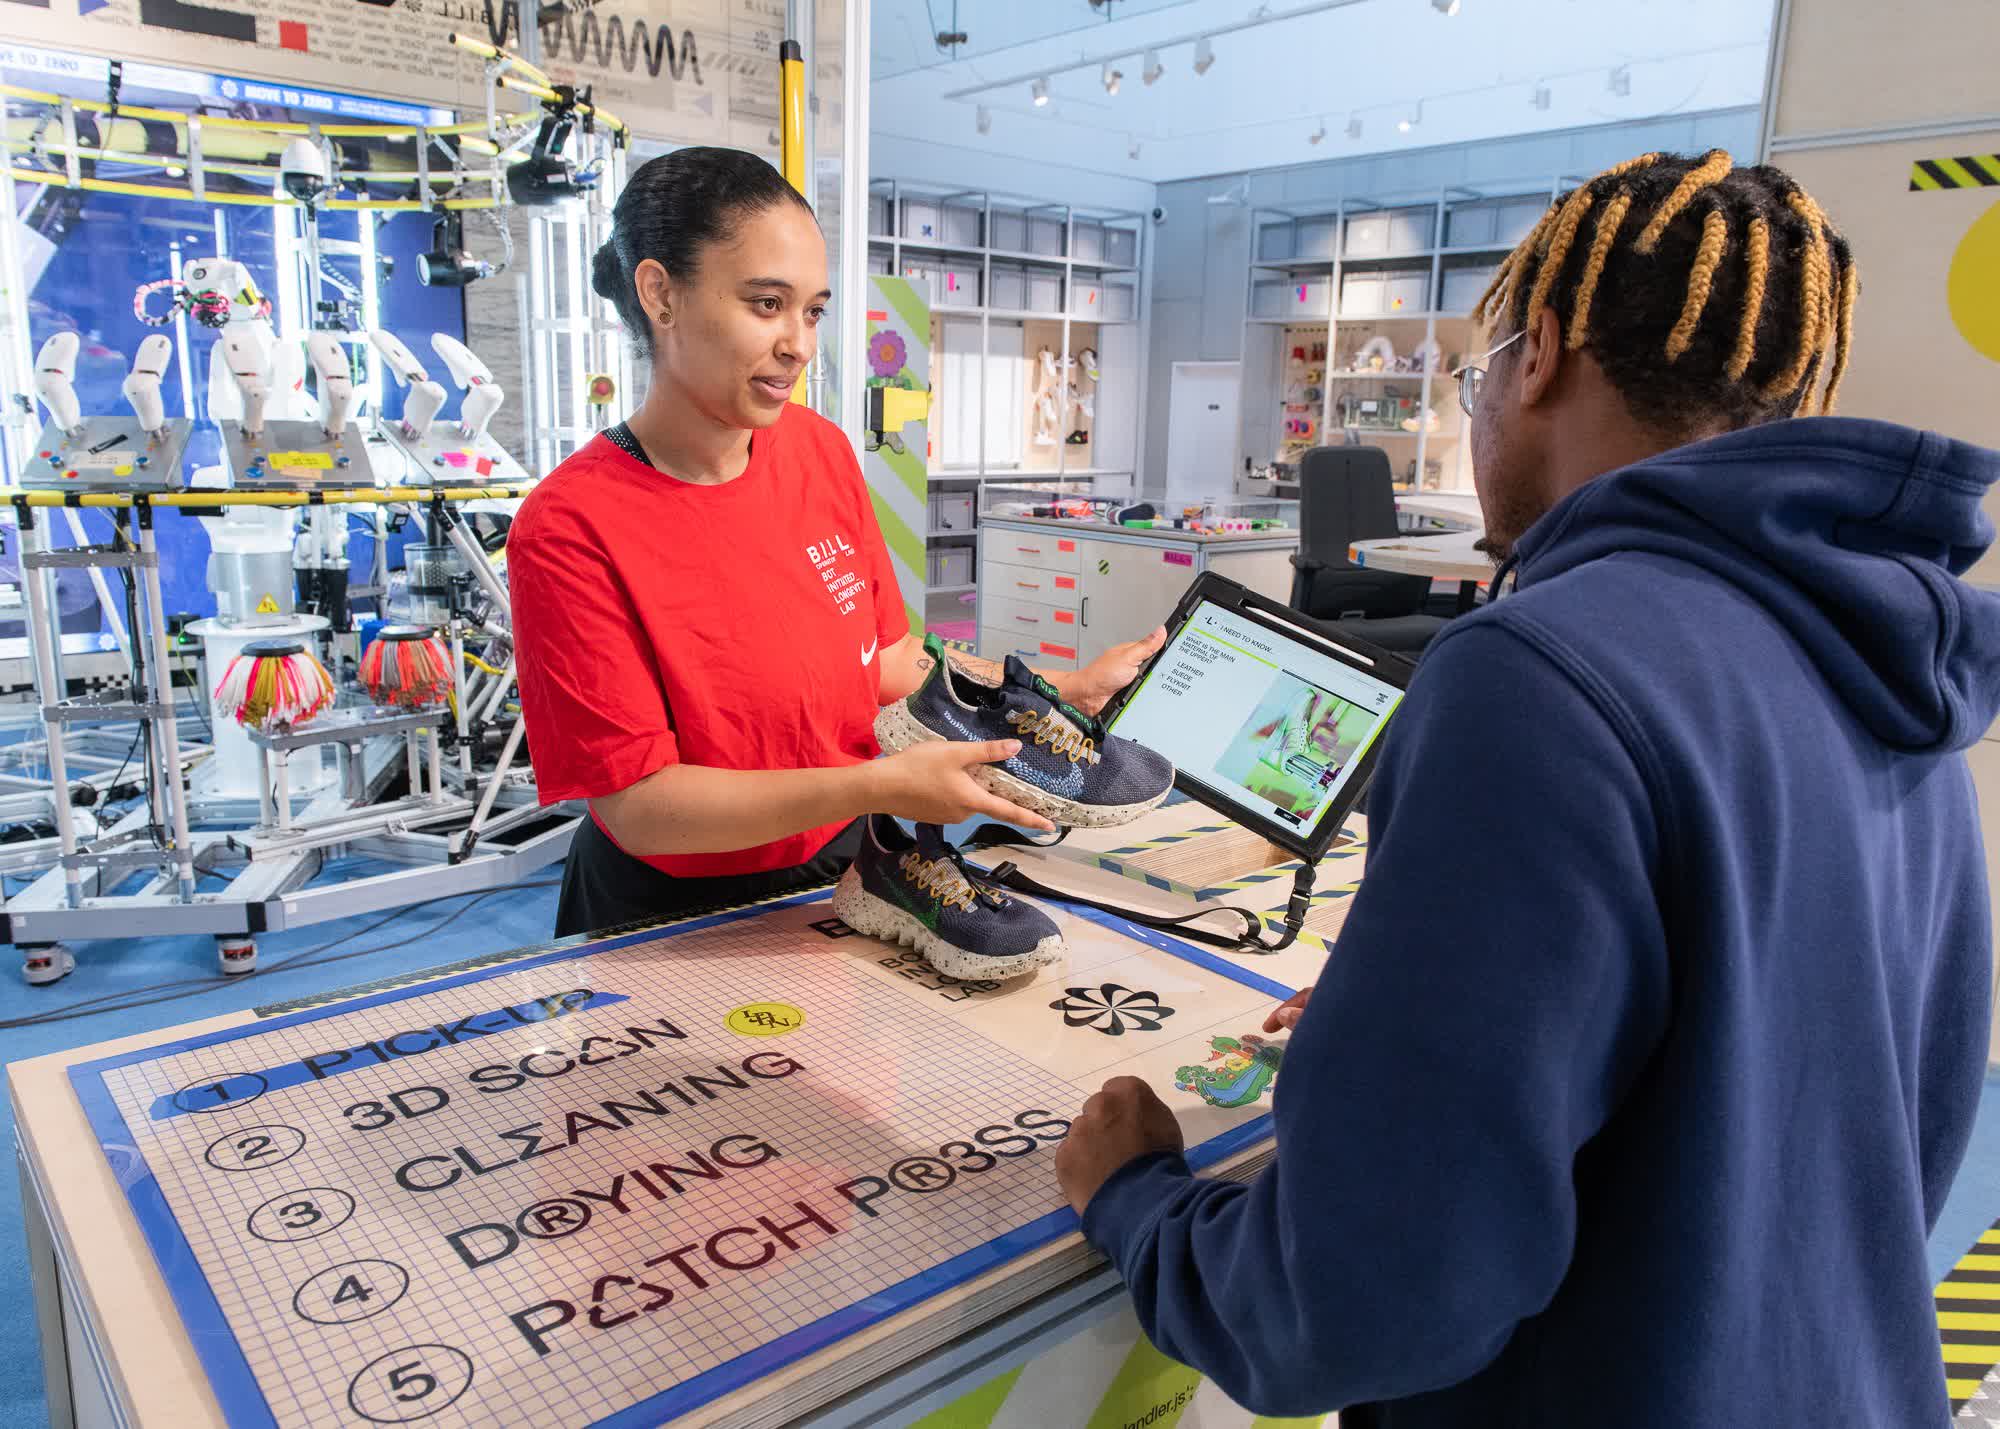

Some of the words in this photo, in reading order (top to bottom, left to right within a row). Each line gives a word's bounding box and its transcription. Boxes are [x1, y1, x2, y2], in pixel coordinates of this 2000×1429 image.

[821, 567, 836, 582] BOT
[839, 600, 855, 616] LAB
[1224, 626, 1241, 639] NEED
[1241, 634, 1251, 643] TO
[1178, 645, 1190, 655] THE
[1189, 650, 1213, 664] UPPER?
[1182, 641, 1208, 657] MATERIAL
[1209, 653, 1218, 661] OF
[1185, 635, 1202, 647] WHAT
[1208, 646, 1220, 655] THE
[1220, 651, 1236, 663] MAIN
[1171, 668, 1193, 682] SUEDE
[1176, 661, 1204, 678] LEATHER
[1161, 683, 1183, 697] OTHER
[1166, 675, 1191, 691] FLYKNIT
[236, 1135, 278, 1161] 2
[343, 1085, 450, 1132] 3D
[278, 1200, 322, 1229] 3
[332, 1274, 373, 1305] 4
[387, 1360, 437, 1402] 5
